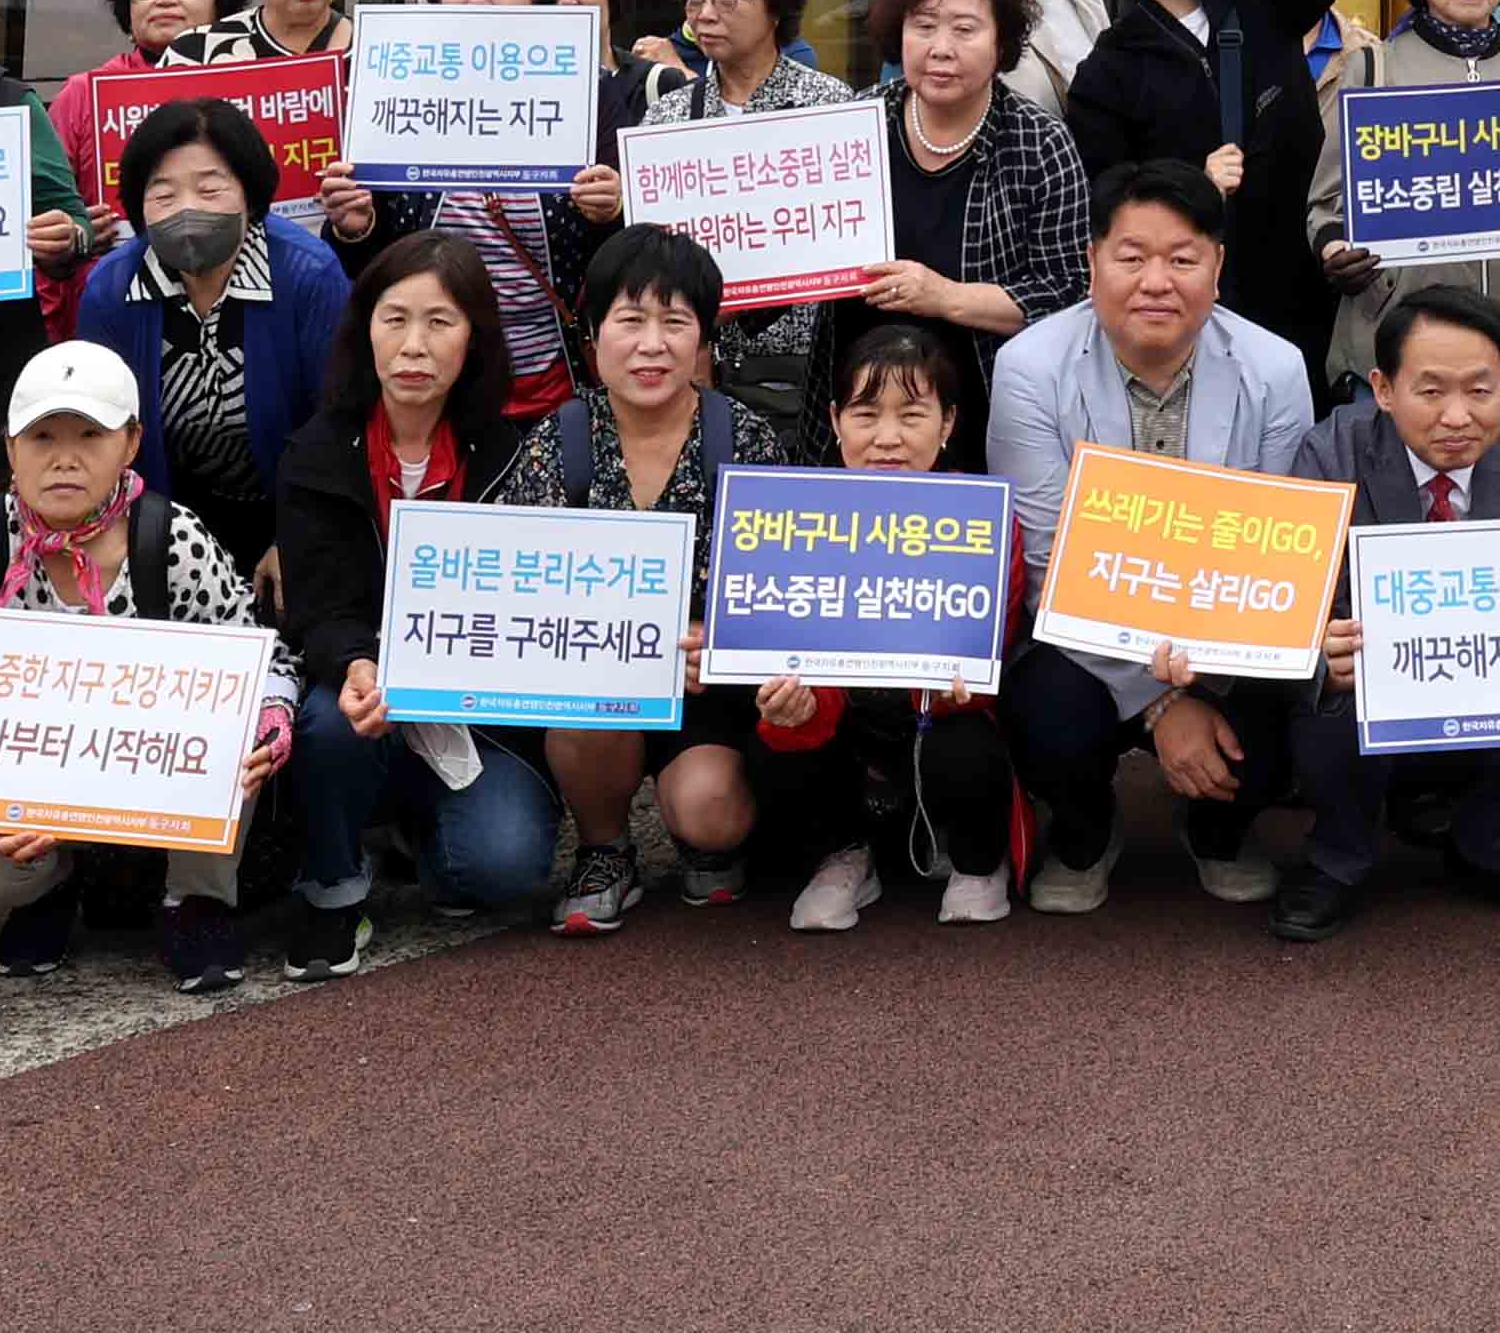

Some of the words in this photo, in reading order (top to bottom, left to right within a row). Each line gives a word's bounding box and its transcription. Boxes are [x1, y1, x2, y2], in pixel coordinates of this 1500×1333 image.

[366, 42, 461, 82] 대중교통
[470, 42, 578, 81] 이용으로
[371, 97, 502, 136] 깨끗해지는
[509, 97, 564, 136] 지구
[1356, 119, 1466, 160] 장바구니
[637, 160, 728, 204] 함께하는
[734, 145, 822, 191] 탄소중립
[829, 138, 871, 181] 실천
[1357, 173, 1460, 214] 탄소중립
[773, 204, 816, 245] 우리
[822, 200, 865, 238] 지구
[731, 509, 859, 553] 장바구니
[866, 513, 994, 557] 사용으로
[1080, 488, 1204, 544] 쓰레기는
[409, 544, 503, 592] 올바른
[511, 549, 669, 598] 분리수거로
[1089, 551, 1182, 603] 지구는
[1189, 568, 1295, 613] 살리GO
[1374, 566, 1500, 615] 대중교통
[724, 572, 845, 618] 탄소중립
[854, 576, 990, 620] 실천하GO
[404, 610, 499, 658] 지구를
[506, 616, 663, 663] 구해주세요
[52, 659, 105, 704] 지구
[111, 663, 166, 709] 건강
[169, 668, 249, 716] 지키기
[80, 726, 209, 777] 시작해요
